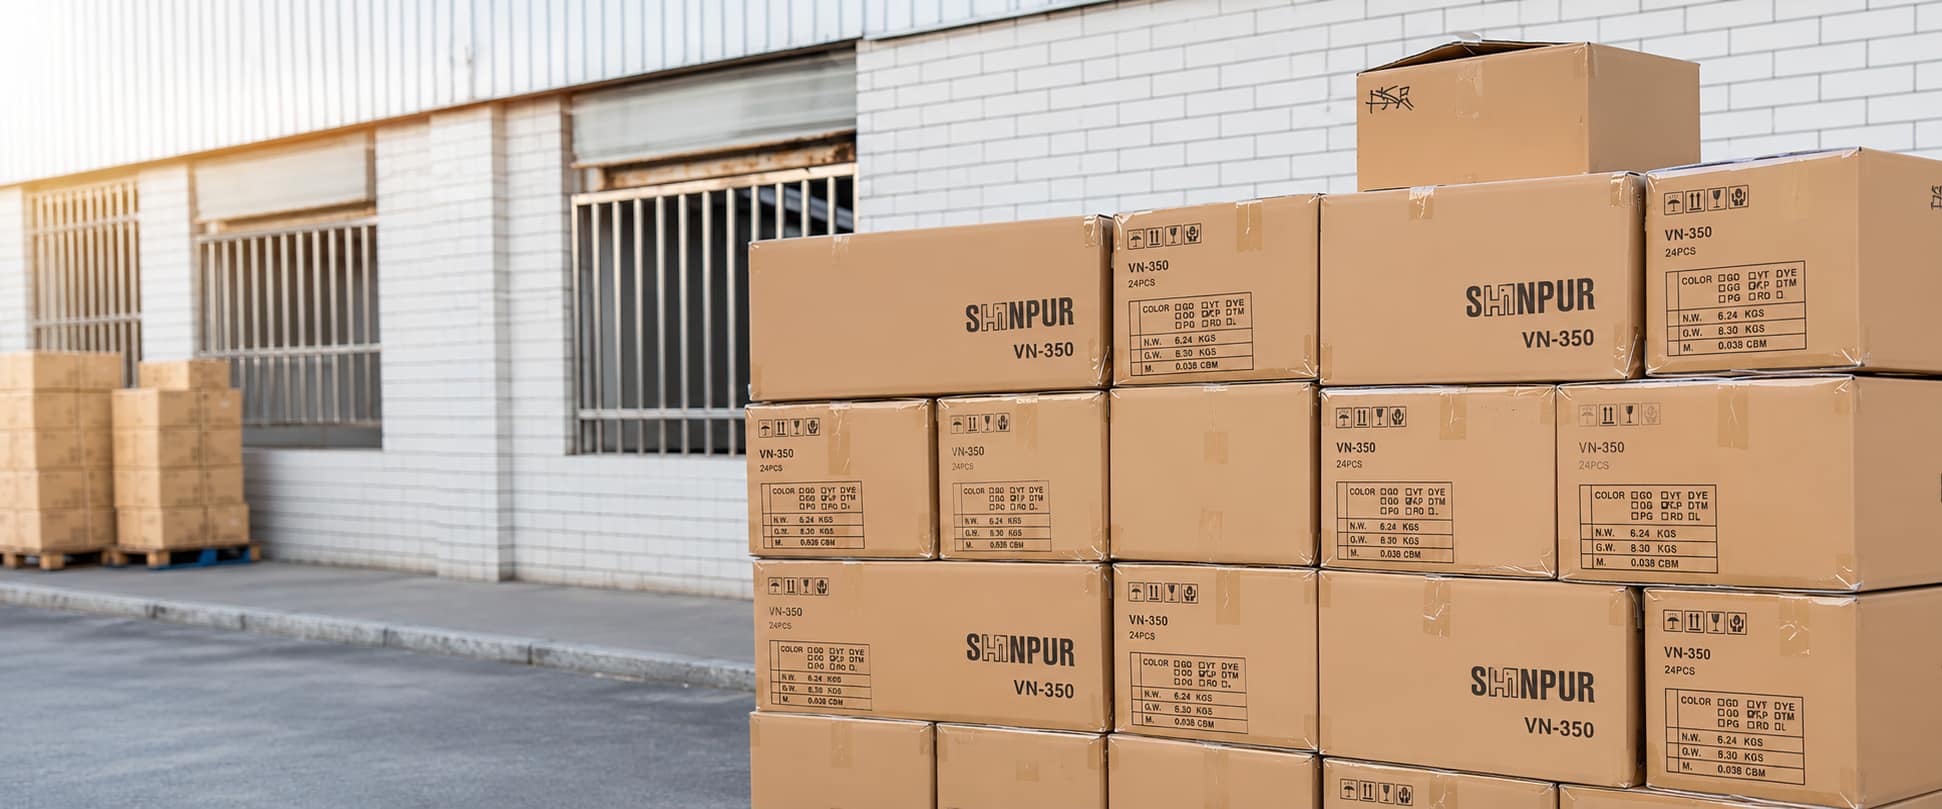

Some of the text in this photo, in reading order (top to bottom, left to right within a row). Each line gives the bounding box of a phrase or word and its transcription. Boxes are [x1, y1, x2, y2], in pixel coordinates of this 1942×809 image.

[1665, 226, 1712, 241] VN-350
[1665, 247, 1696, 257] 24PCS
[1128, 260, 1169, 273] VN-350
[1128, 279, 1156, 288] 24PCS
[1681, 275, 1712, 285] COLOR
[1143, 304, 1169, 314] COLOR
[1682, 309, 1765, 323] N.W. 6.24 KGS
[1718, 325, 1738, 335] 8.30
[1745, 324, 1765, 333] KGS
[1143, 335, 1216, 346] N.W. 6.24 KGS
[1522, 329, 1594, 348] VN-350
[1013, 342, 1074, 359] VN-350
[1683, 339, 1767, 352] M. 0.038 CBM
[1199, 348, 1216, 356] KGS
[952, 446, 984, 456] VN-350
[1336, 442, 1376, 453] VN-350
[1579, 442, 1625, 453] VN-350
[760, 449, 794, 458] VN-350
[760, 464, 783, 472] 24PCS
[1336, 460, 1362, 468] 24PCS
[1579, 460, 1609, 470] 24PCS
[1595, 491, 1625, 499] COLOR
[1595, 529, 1615, 537] N.W.
[1630, 529, 1650, 537] 6.24
[1596, 544, 1616, 552] G.W.
[1657, 545, 1677, 553] KGS
[1596, 558, 1679, 568] M. 0.038 CBM
[769, 607, 803, 616] VN-350
[1129, 614, 1168, 626] VN-350
[1129, 631, 1156, 640] 24PCS
[1664, 646, 1711, 660] VN-350
[1143, 658, 1168, 667] COLOR
[1665, 665, 1695, 675] 24PCS
[1013, 680, 1074, 699] VN-350
[1681, 696, 1711, 706] COLOR
[1524, 717, 1594, 738] VN-350
[1682, 733, 1701, 742] N.W.
[1717, 736, 1737, 745] 6.24
[1682, 762, 1693, 771] M.
[1745, 767, 1766, 777] CBM
